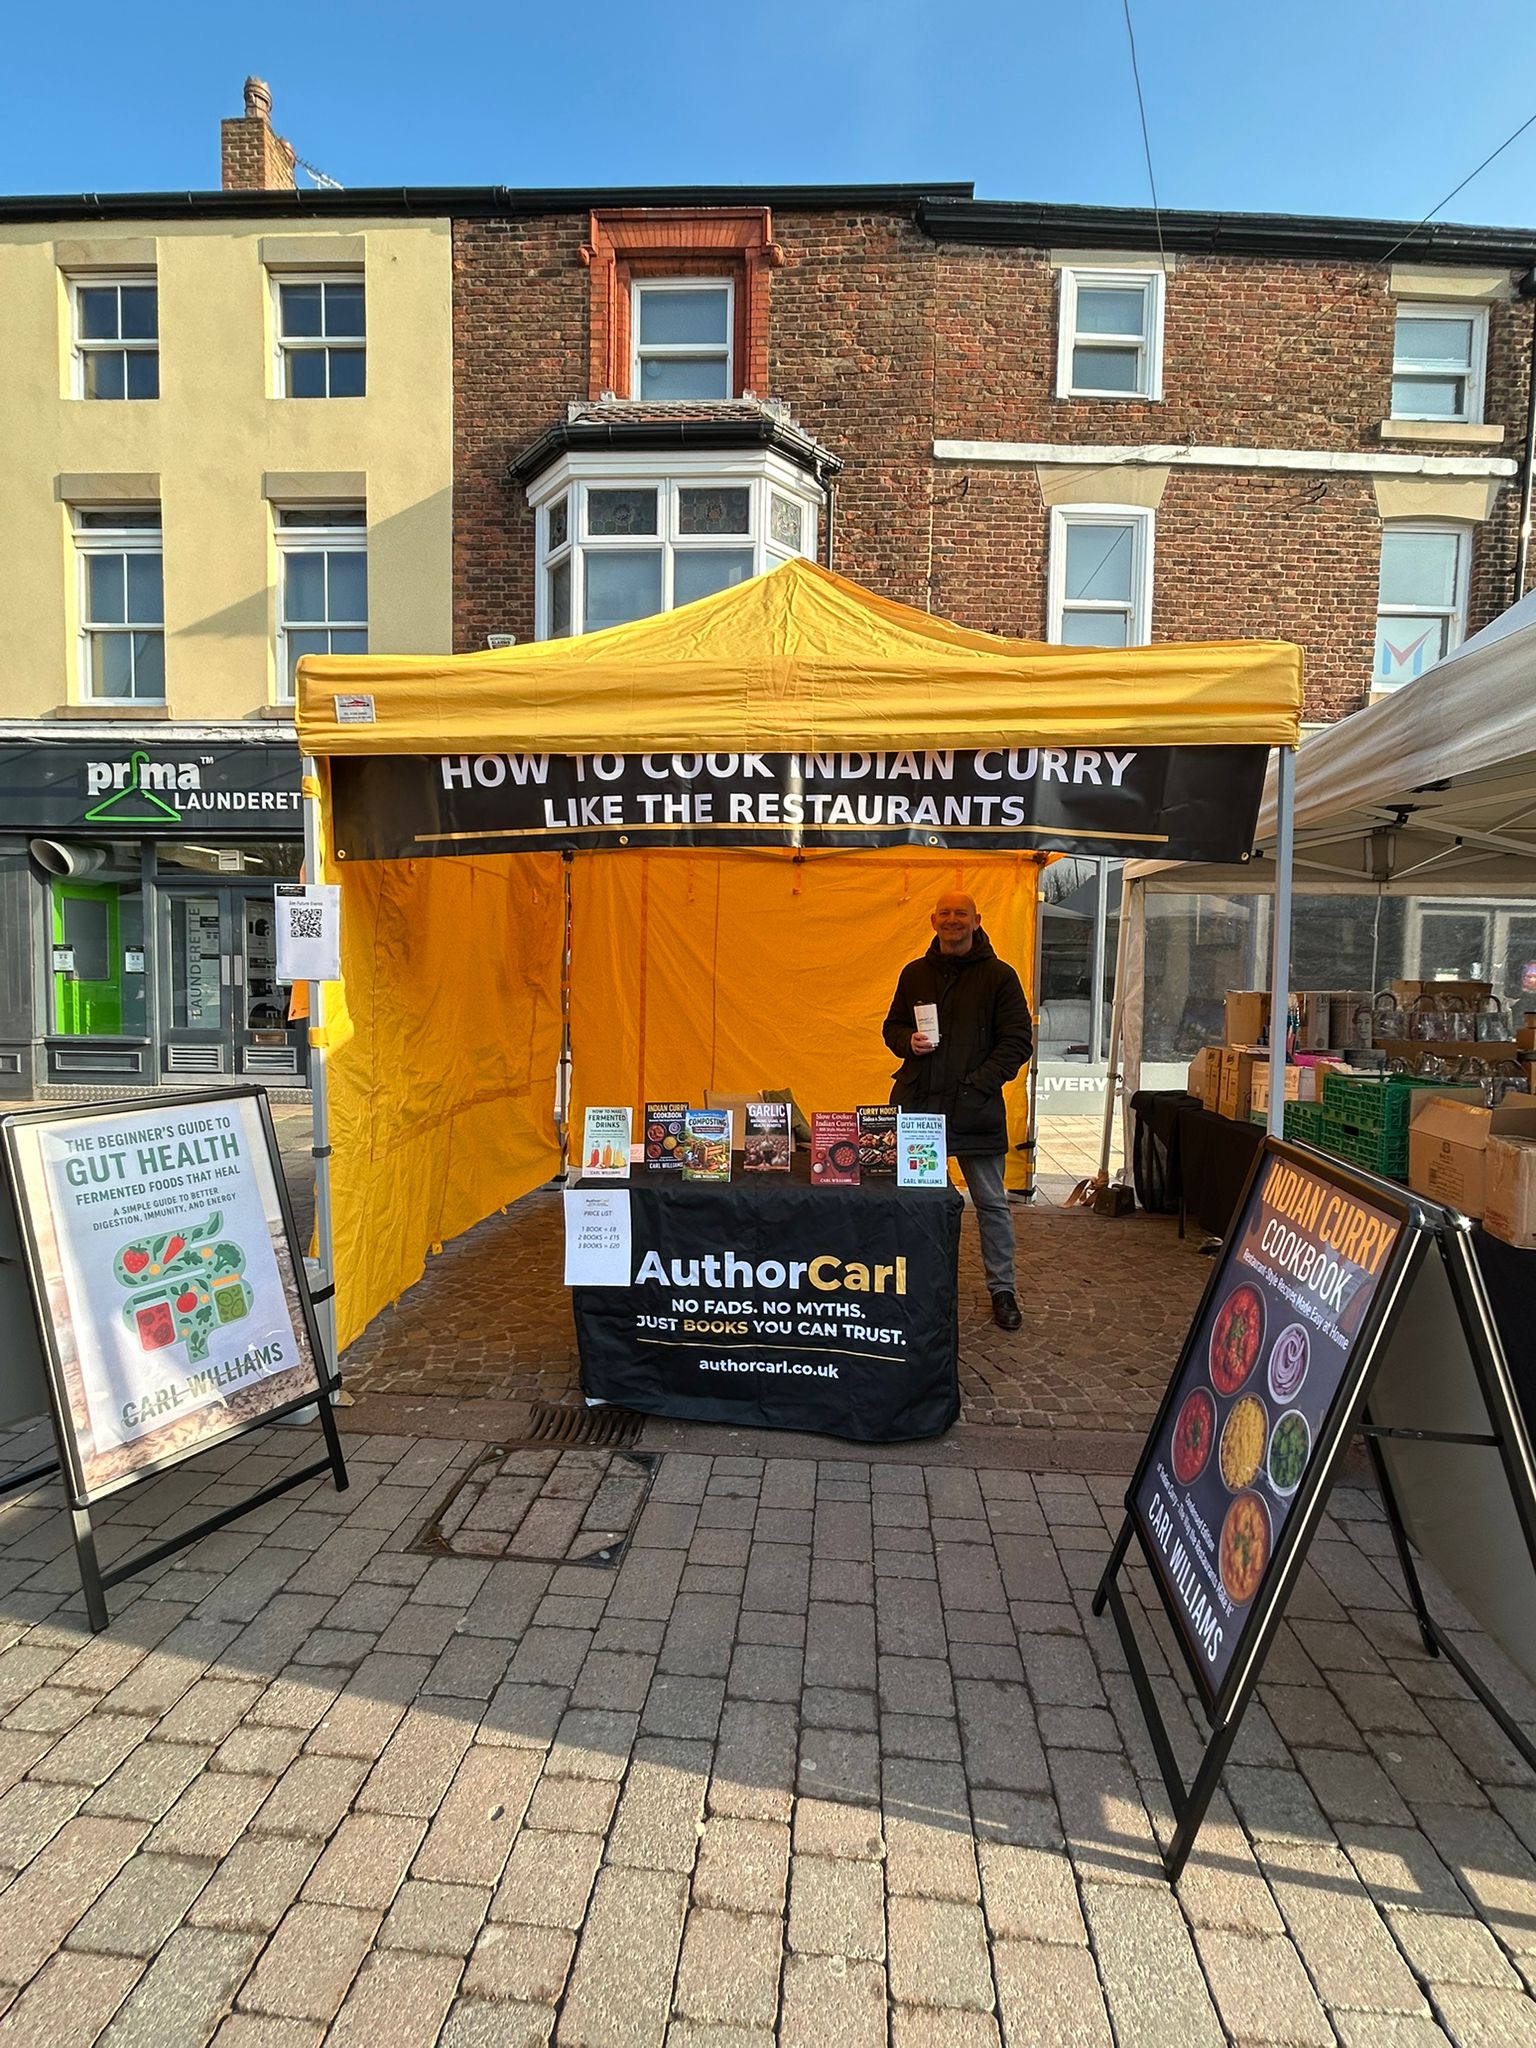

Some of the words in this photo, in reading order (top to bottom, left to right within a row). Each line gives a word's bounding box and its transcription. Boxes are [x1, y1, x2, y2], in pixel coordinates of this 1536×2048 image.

[440, 753, 550, 790] HOW
[567, 752, 626, 783] TO
[642, 752, 775, 782] COOK
[790, 750, 955, 781] INDIAN
[974, 747, 1138, 787] CURRY
[544, 795, 624, 828] LIKE
[637, 793, 714, 824] THE
[729, 792, 1026, 827] RESTAURANTS
[688, 1118, 727, 1126] COMPOSTING
[748, 1104, 786, 1117] GARLIC
[860, 1108, 878, 1116] CURRY
[916, 1122, 943, 1130] HEALTH
[65, 1137, 95, 1153] THE
[98, 1125, 175, 1149] BEGINNER'S
[177, 1118, 214, 1136] GUIDE
[215, 1116, 230, 1129] TO
[65, 1151, 127, 1186] GUT
[137, 1132, 241, 1175] HEALTH
[76, 1183, 147, 1206] FERMENTED
[149, 1175, 184, 1193] FOODS
[186, 1169, 212, 1184] THAT
[215, 1164, 240, 1179] HEAL
[113, 1207, 120, 1216] A
[121, 1201, 152, 1215] SIMPLE
[153, 1196, 177, 1209] GUIDE
[179, 1193, 189, 1202] TO
[191, 1186, 219, 1200] BETTER
[92, 1215, 143, 1231] DIGESTION,
[144, 1207, 187, 1221] IMMUNITY,
[188, 1200, 205, 1211] AND
[207, 1192, 237, 1207] ENERGY
[1262, 1162, 1327, 1233] INDIAN
[1318, 1195, 1396, 1275] CURRY
[634, 1250, 907, 1295] AuthorCarl
[1260, 1218, 1353, 1313] COOKBOOK
[671, 1299, 699, 1313] NO
[704, 1300, 758, 1315] FADS.
[763, 1301, 792, 1315] NO
[796, 1302, 866, 1319] MYTHS.
[1277, 1277, 1298, 1303] Recipes
[1295, 1294, 1312, 1317] Made
[1310, 1306, 1324, 1330] Easy
[1322, 1320, 1332, 1335] at
[1329, 1323, 1350, 1350] Home
[636, 1315, 679, 1331] JUST
[683, 1319, 749, 1335] BOOKS
[753, 1320, 793, 1334] YOU
[797, 1321, 838, 1337] CAN
[842, 1324, 907, 1346] TRUST.
[121, 1384, 184, 1428] CARL
[186, 1342, 283, 1398] WILLIAMS
[699, 1357, 840, 1379] authorcarl.co.uk
[1148, 1492, 1174, 1555] CARL
[1169, 1536, 1224, 1663] WILLIAMS
